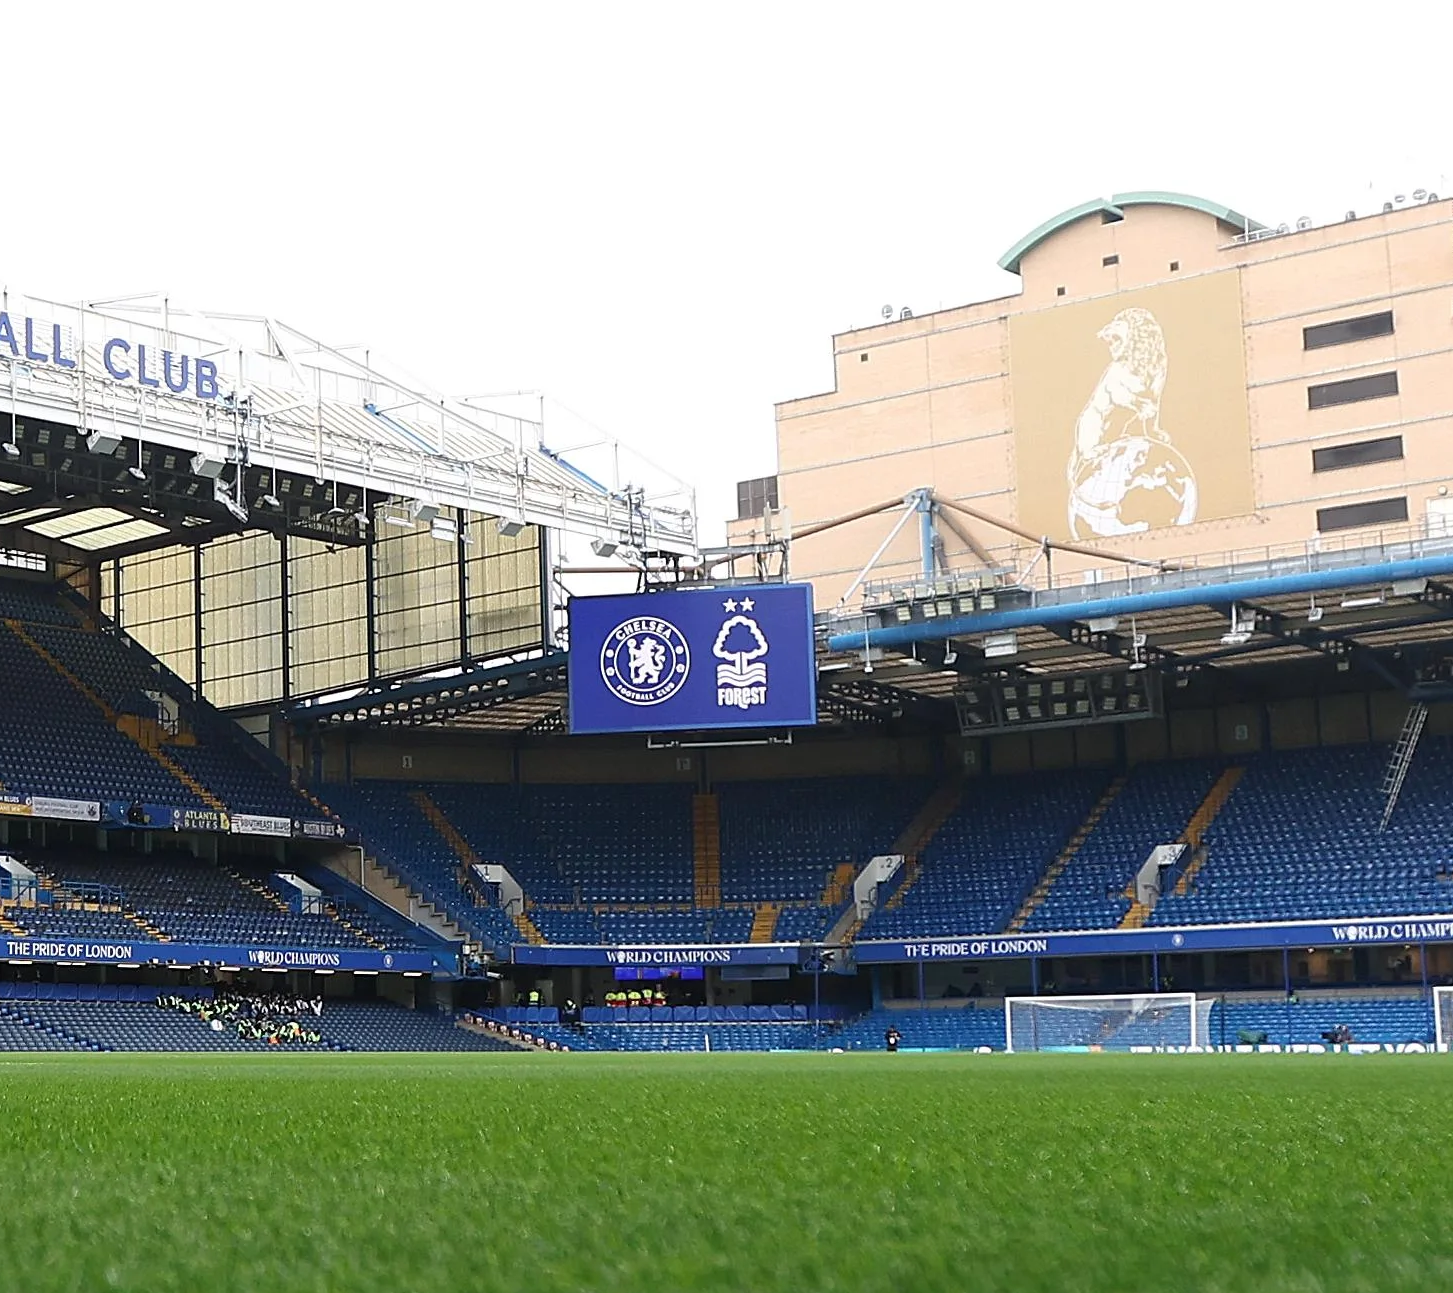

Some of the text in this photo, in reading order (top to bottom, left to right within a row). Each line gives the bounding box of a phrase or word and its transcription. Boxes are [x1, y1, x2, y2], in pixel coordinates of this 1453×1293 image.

[103, 337, 222, 401] CLUB
[615, 620, 673, 641] CHELSEA
[616, 682, 675, 700] FOOTBALL CLUB
[4, 795, 20, 803] BLUES
[184, 811, 218, 821] ATLANTA
[184, 819, 218, 829] BLUES
[1168, 846, 1177, 858] 3
[885, 857, 893, 869] 2
[483, 865, 490, 876] 1
[7, 941, 132, 959] THE PRIDE OF LONDON
[904, 939, 1047, 957] THE PRIDE OF LONDON
[284, 951, 340, 966] CHAMPIONS
[653, 949, 731, 963] CHAMPIONS
